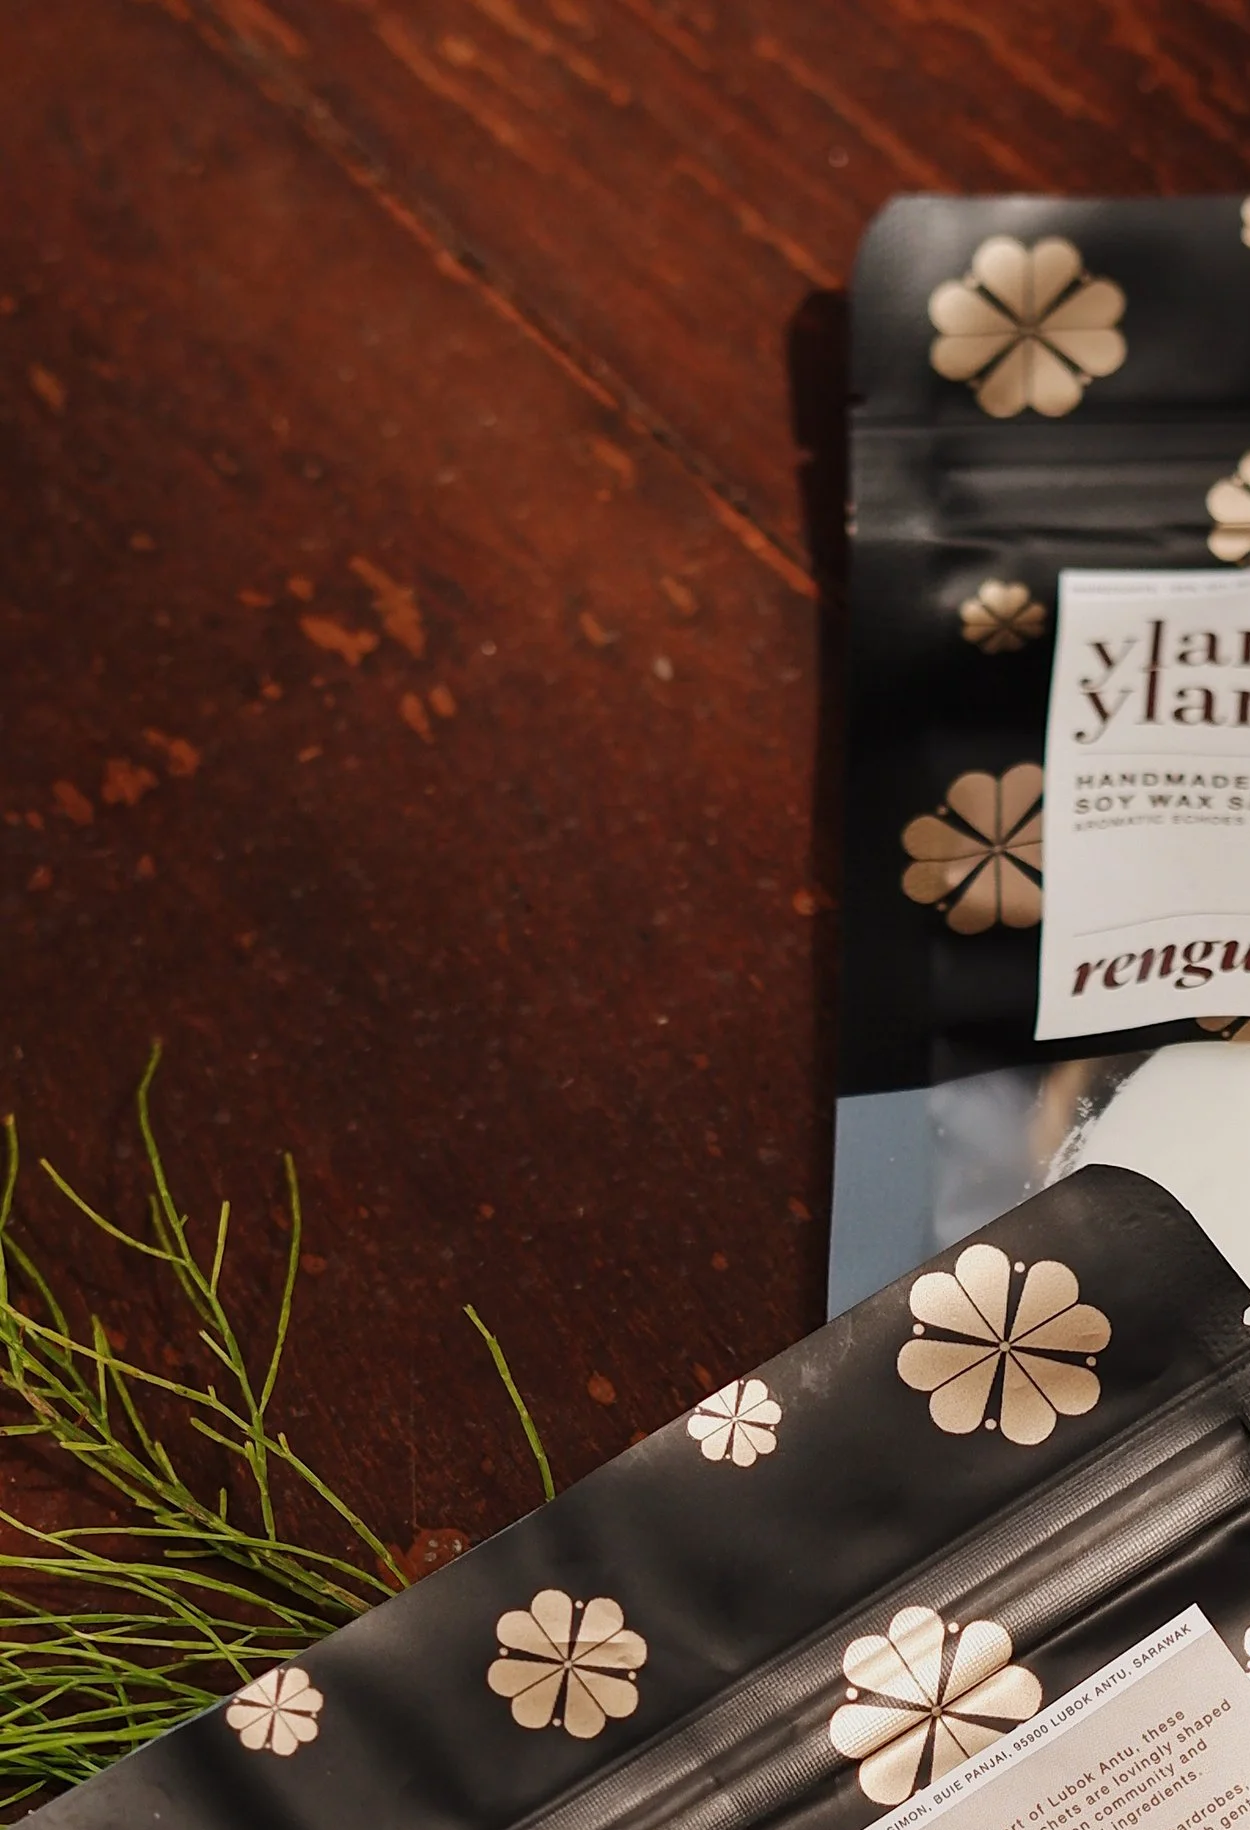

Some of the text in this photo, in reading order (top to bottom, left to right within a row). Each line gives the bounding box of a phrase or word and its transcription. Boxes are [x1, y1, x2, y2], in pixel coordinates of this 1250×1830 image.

[1074, 795, 1135, 814] SOY
[1148, 794, 1213, 811] WAX
[1076, 772, 1250, 790] HANDMADE
[932, 1779, 964, 1805] BUIE
[964, 1750, 1012, 1783] PANJAI,
[1012, 1724, 1049, 1751] 95900
[1049, 1693, 1093, 1727] LUBOK
[1094, 1668, 1132, 1697] ANTU,
[1132, 1623, 1191, 1668] SARAWAK
[1085, 1785, 1110, 1805] are
[1111, 1741, 1172, 1787] lovingly
[1176, 1698, 1231, 1743] shaped
[1028, 1803, 1045, 1821] of
[1046, 1772, 1096, 1807] Lubok
[1099, 1746, 1140, 1775] Antu,
[1141, 1711, 1185, 1743] these
[1094, 1762, 1175, 1821] community
[1179, 1737, 1207, 1764] and
